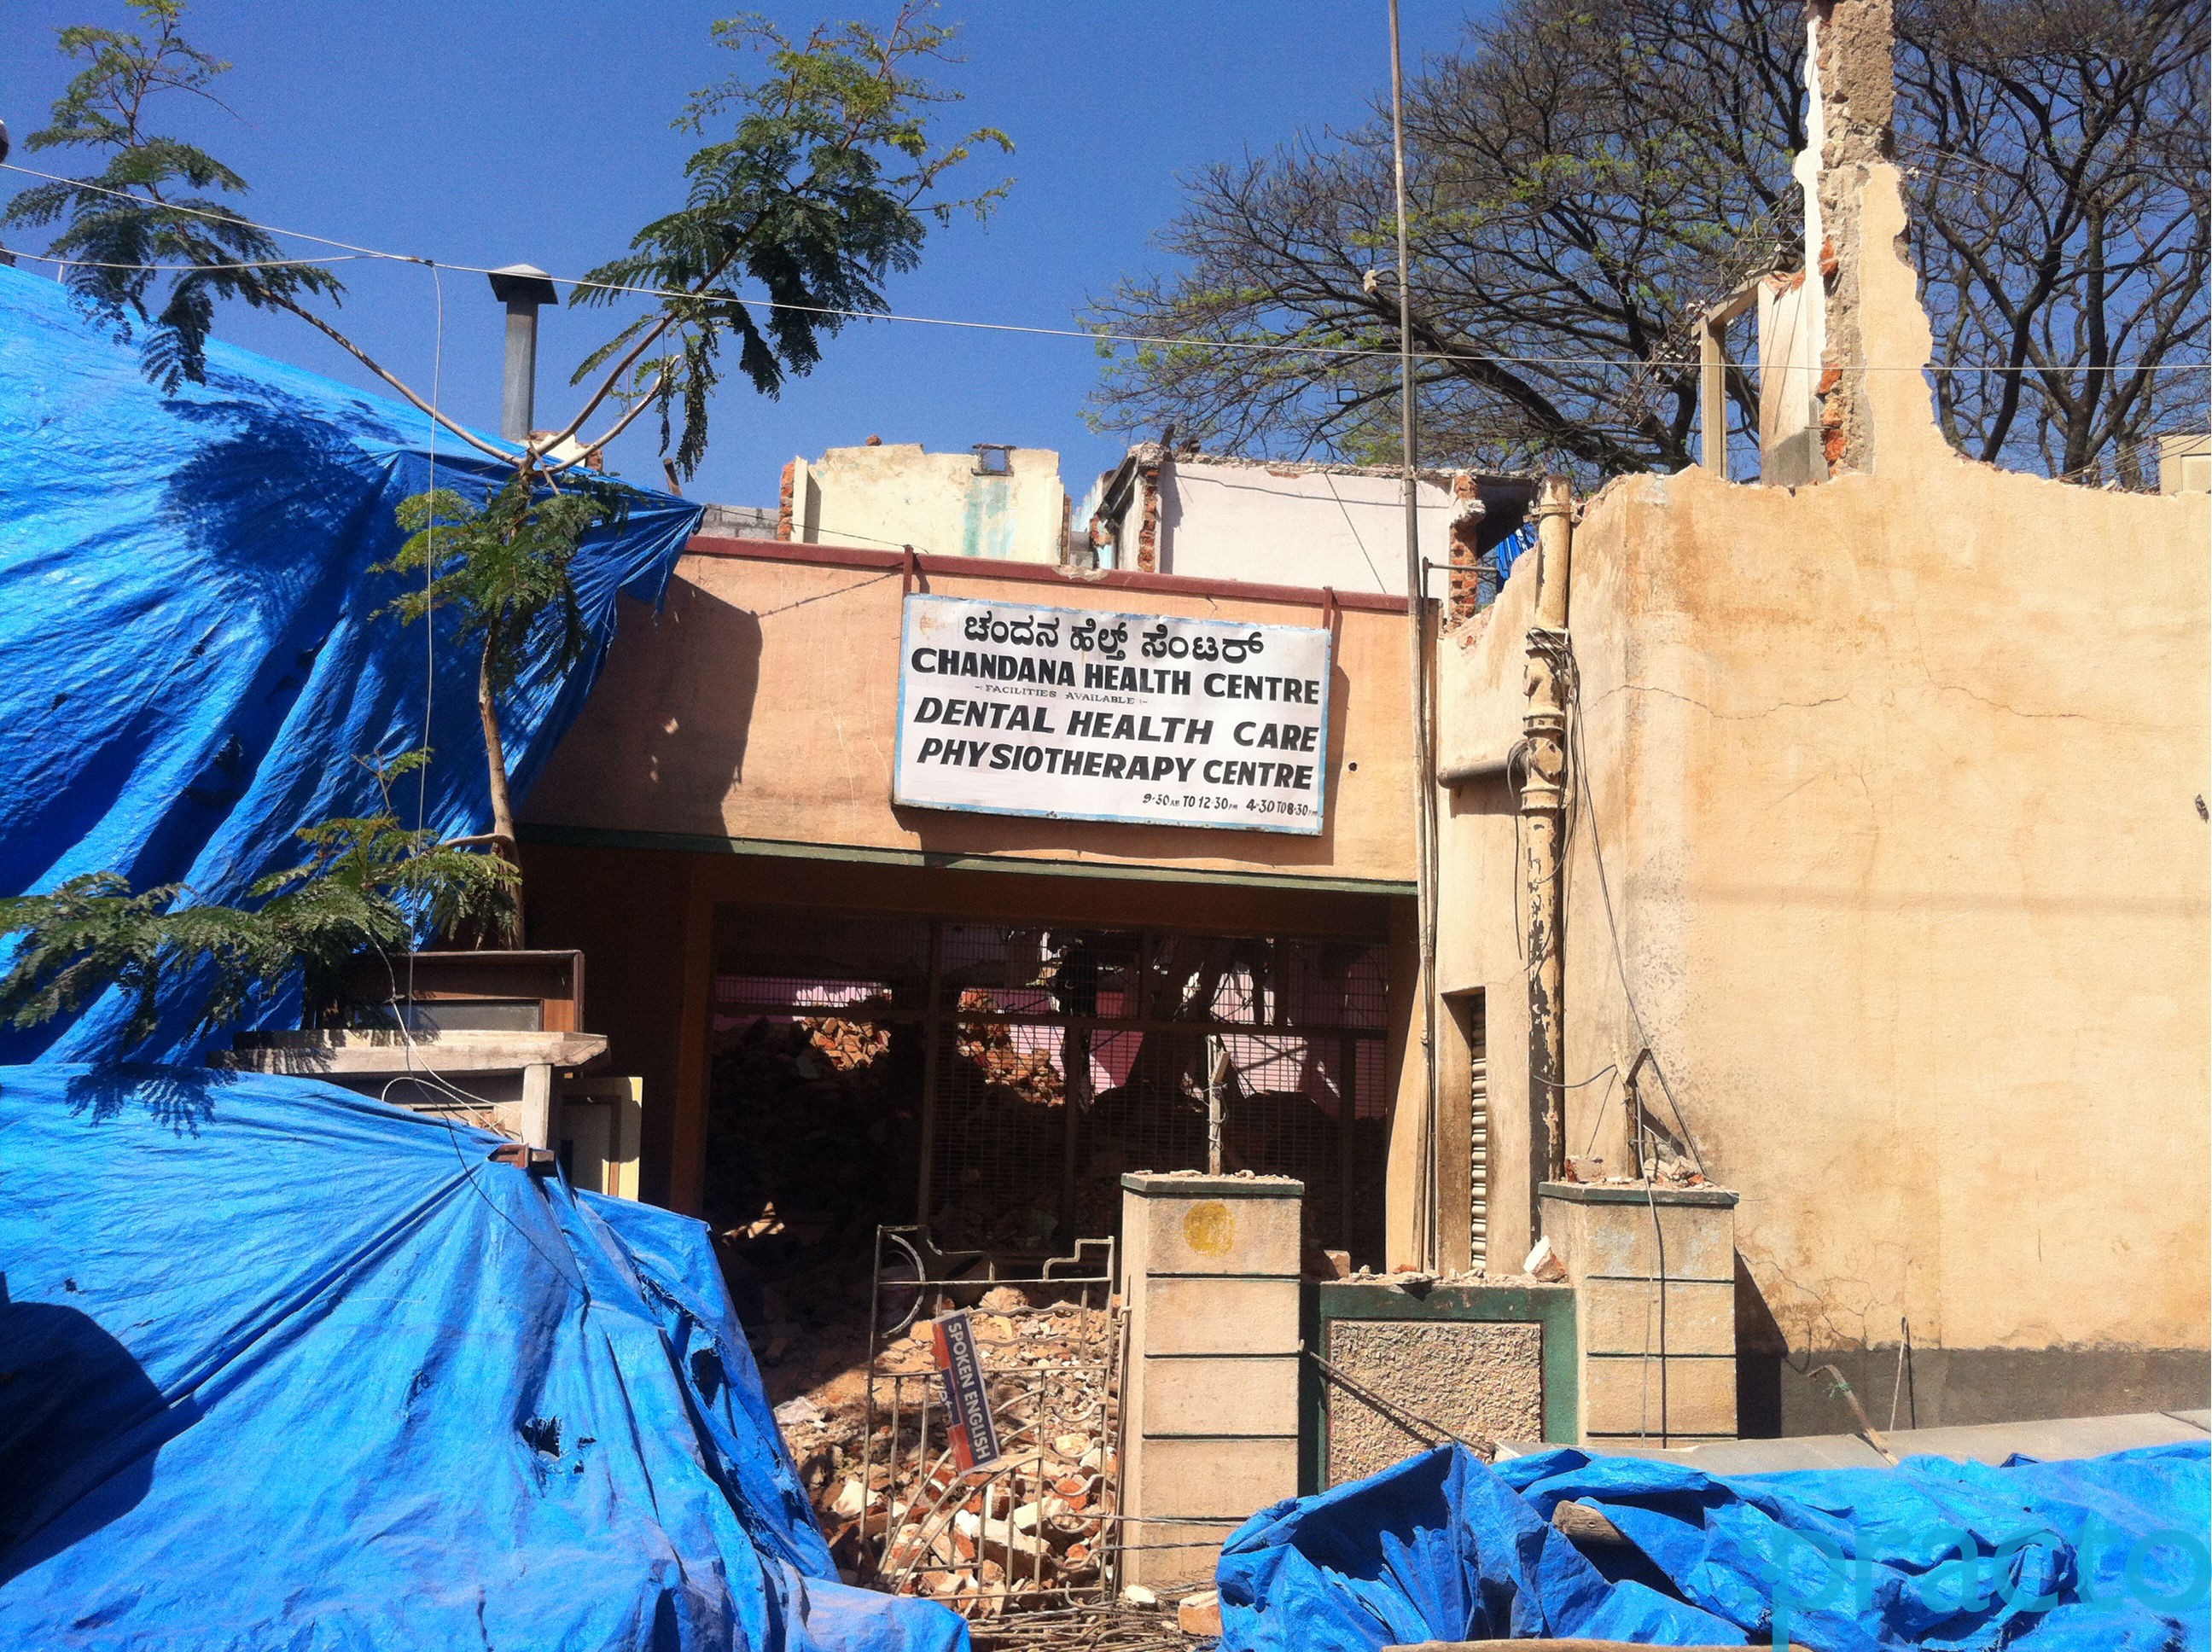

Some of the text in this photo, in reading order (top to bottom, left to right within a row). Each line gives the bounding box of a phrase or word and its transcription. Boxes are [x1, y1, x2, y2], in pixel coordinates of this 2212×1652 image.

[963, 610, 1061, 649] ಚಂದನ
[1141, 623, 1265, 665] ಸೆಂಟರ್
[911, 647, 1320, 705] CHANDANA HEALTH CENTRE
[985, 684, 1057, 698] FACILITIES
[1065, 692, 1136, 705] AVAILABLE
[913, 696, 1320, 752] DENTAL HEALTH CARE
[916, 736, 1314, 790] PHYSIOTHERAPY CENTRE
[947, 1323, 991, 1461] SPOKEN ENGLISH
